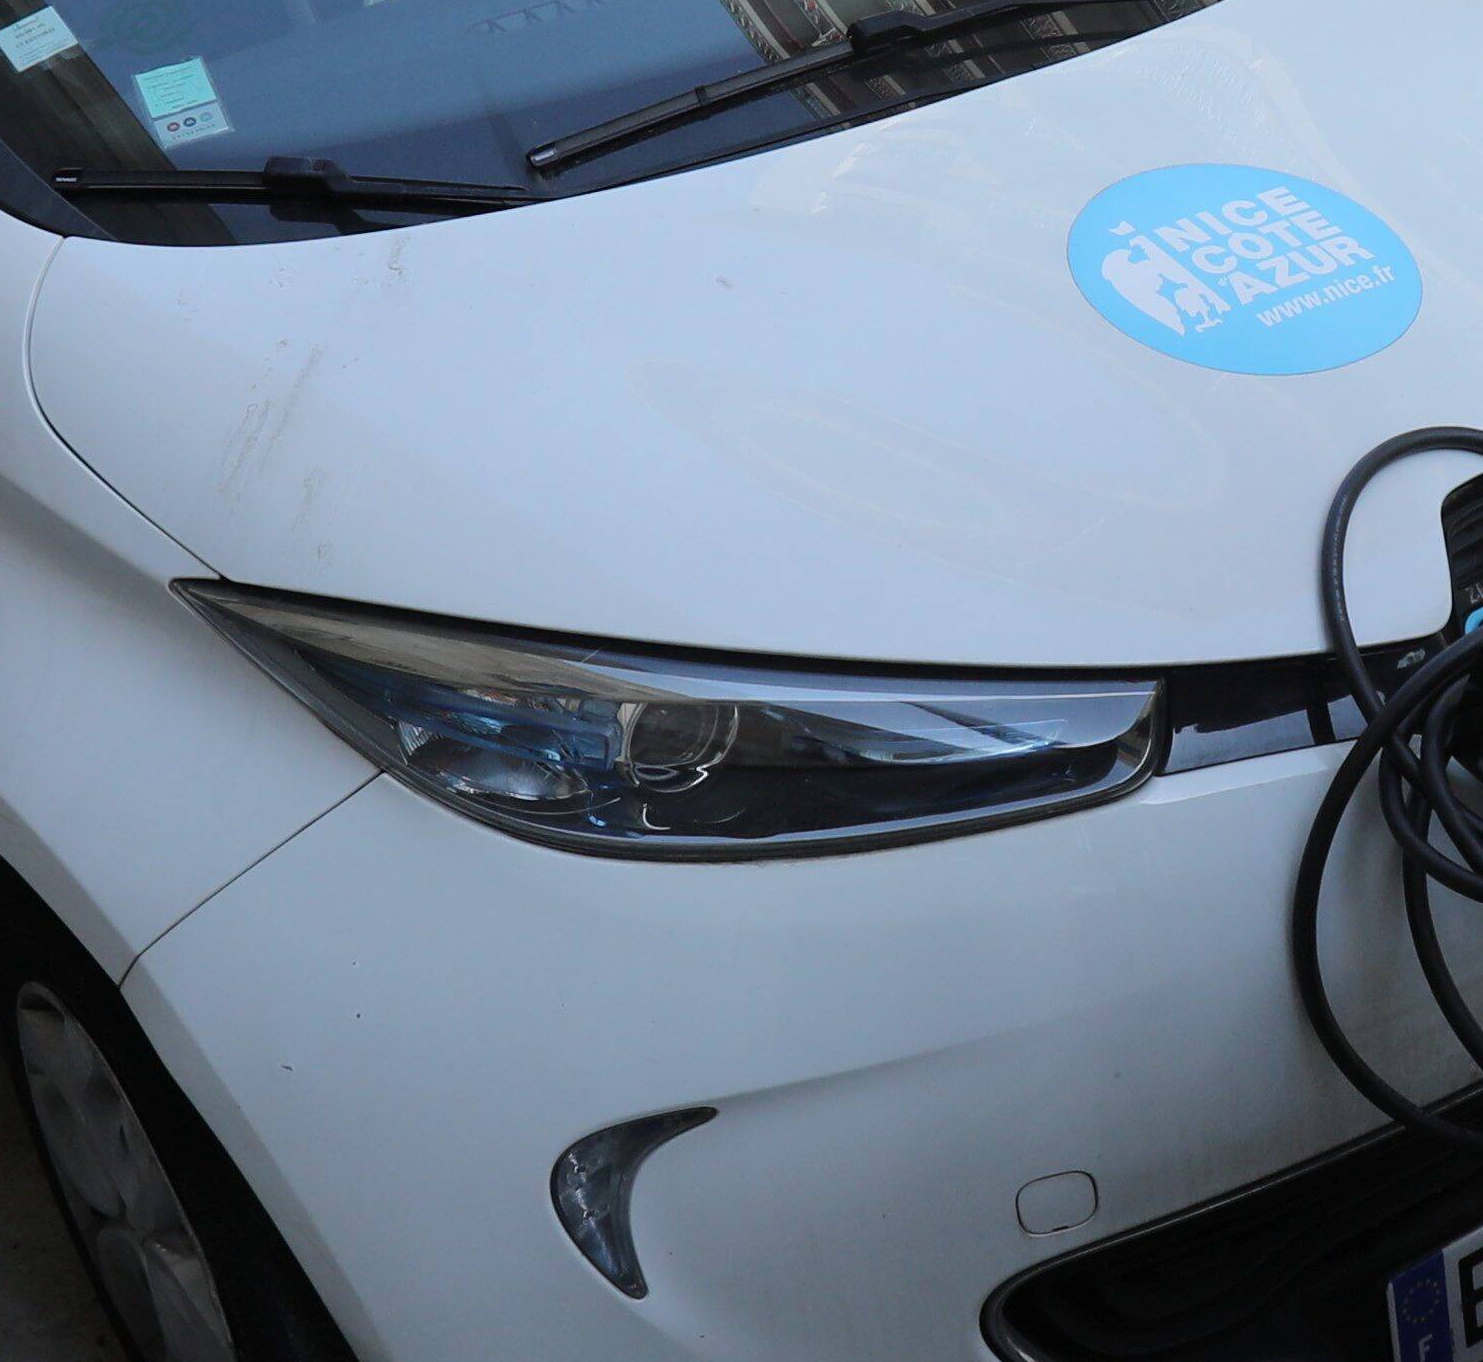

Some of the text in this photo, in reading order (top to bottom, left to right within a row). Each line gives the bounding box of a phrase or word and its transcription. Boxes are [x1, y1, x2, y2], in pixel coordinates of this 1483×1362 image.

[1153, 186, 1311, 253] NICE
[1191, 210, 1343, 275] COTE
[1256, 263, 1397, 328] www.nice.fr
